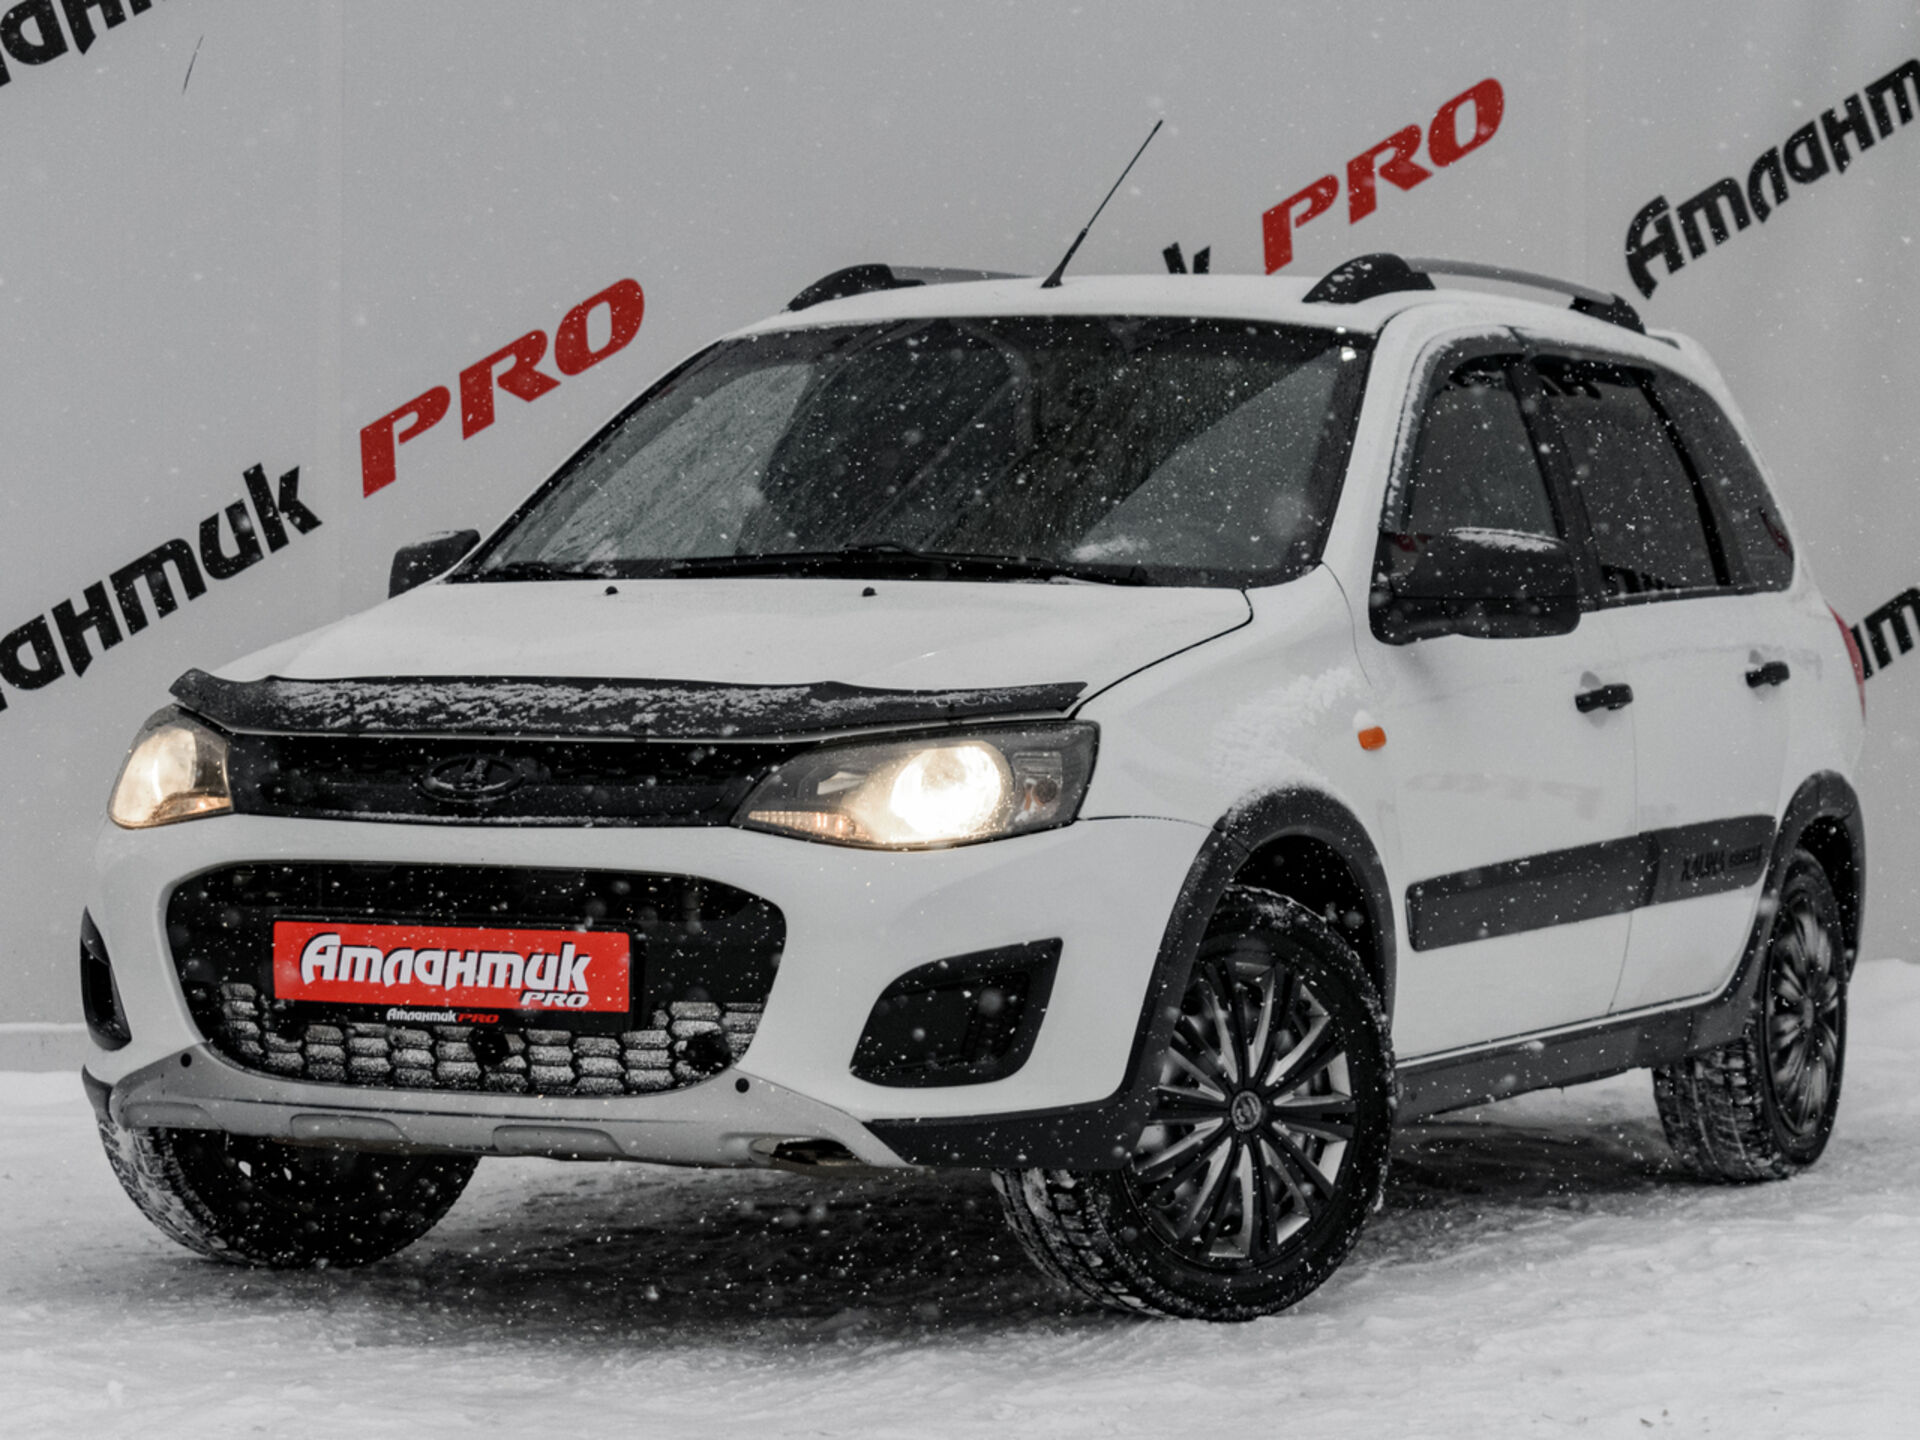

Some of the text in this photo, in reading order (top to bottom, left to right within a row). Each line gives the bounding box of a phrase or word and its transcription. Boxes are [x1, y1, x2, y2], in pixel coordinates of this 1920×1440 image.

[1261, 77, 1505, 275] PRO
[0, 278, 645, 712] антик PRO
[300, 932, 592, 991] Атлантик
[386, 1007, 500, 1024] Атлантик PRO
[519, 990, 590, 1008] PRO
